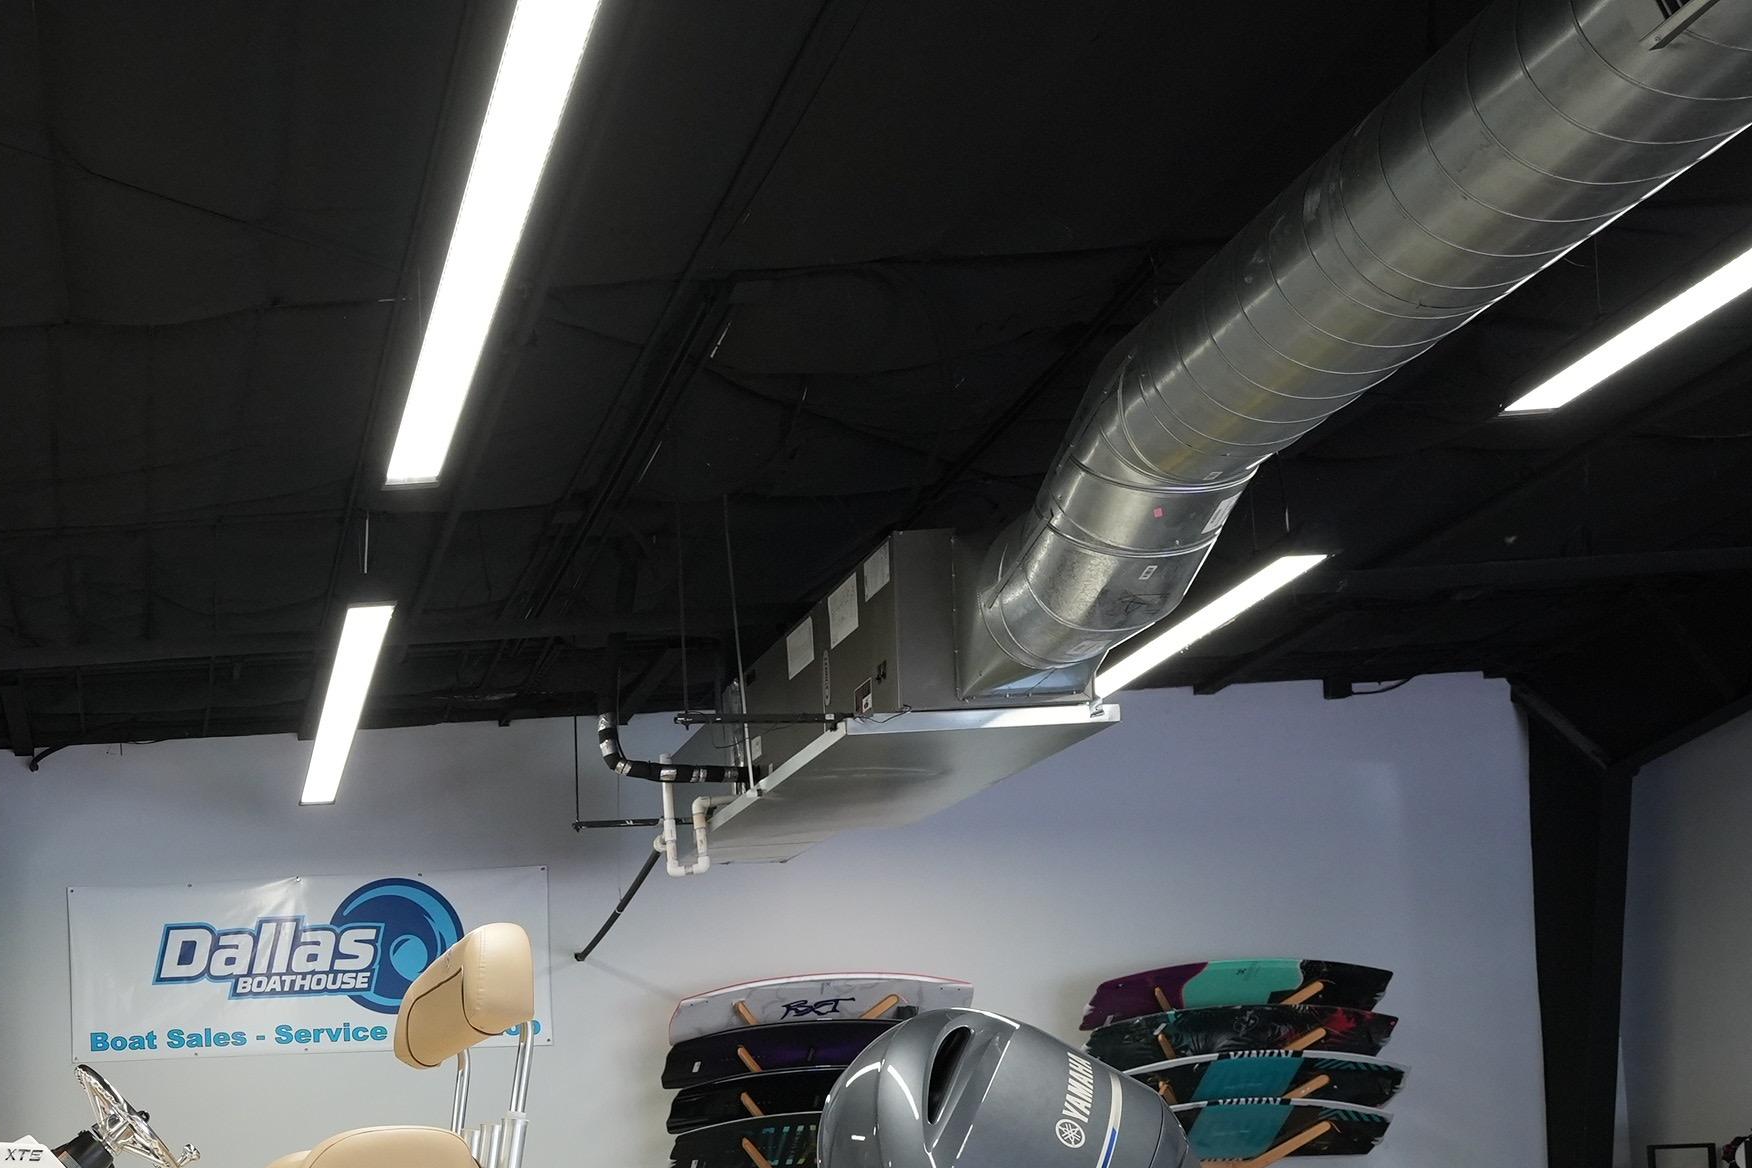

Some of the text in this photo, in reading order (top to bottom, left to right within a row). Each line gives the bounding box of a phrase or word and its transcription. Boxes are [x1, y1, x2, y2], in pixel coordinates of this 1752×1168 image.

[159, 921, 377, 979] Dallas
[235, 971, 371, 994] BOATHOUSE
[90, 1030, 157, 1052] Boat
[166, 1028, 247, 1050] Sales
[274, 1022, 389, 1045] Service
[1062, 1051, 1094, 1124] YAMAHA
